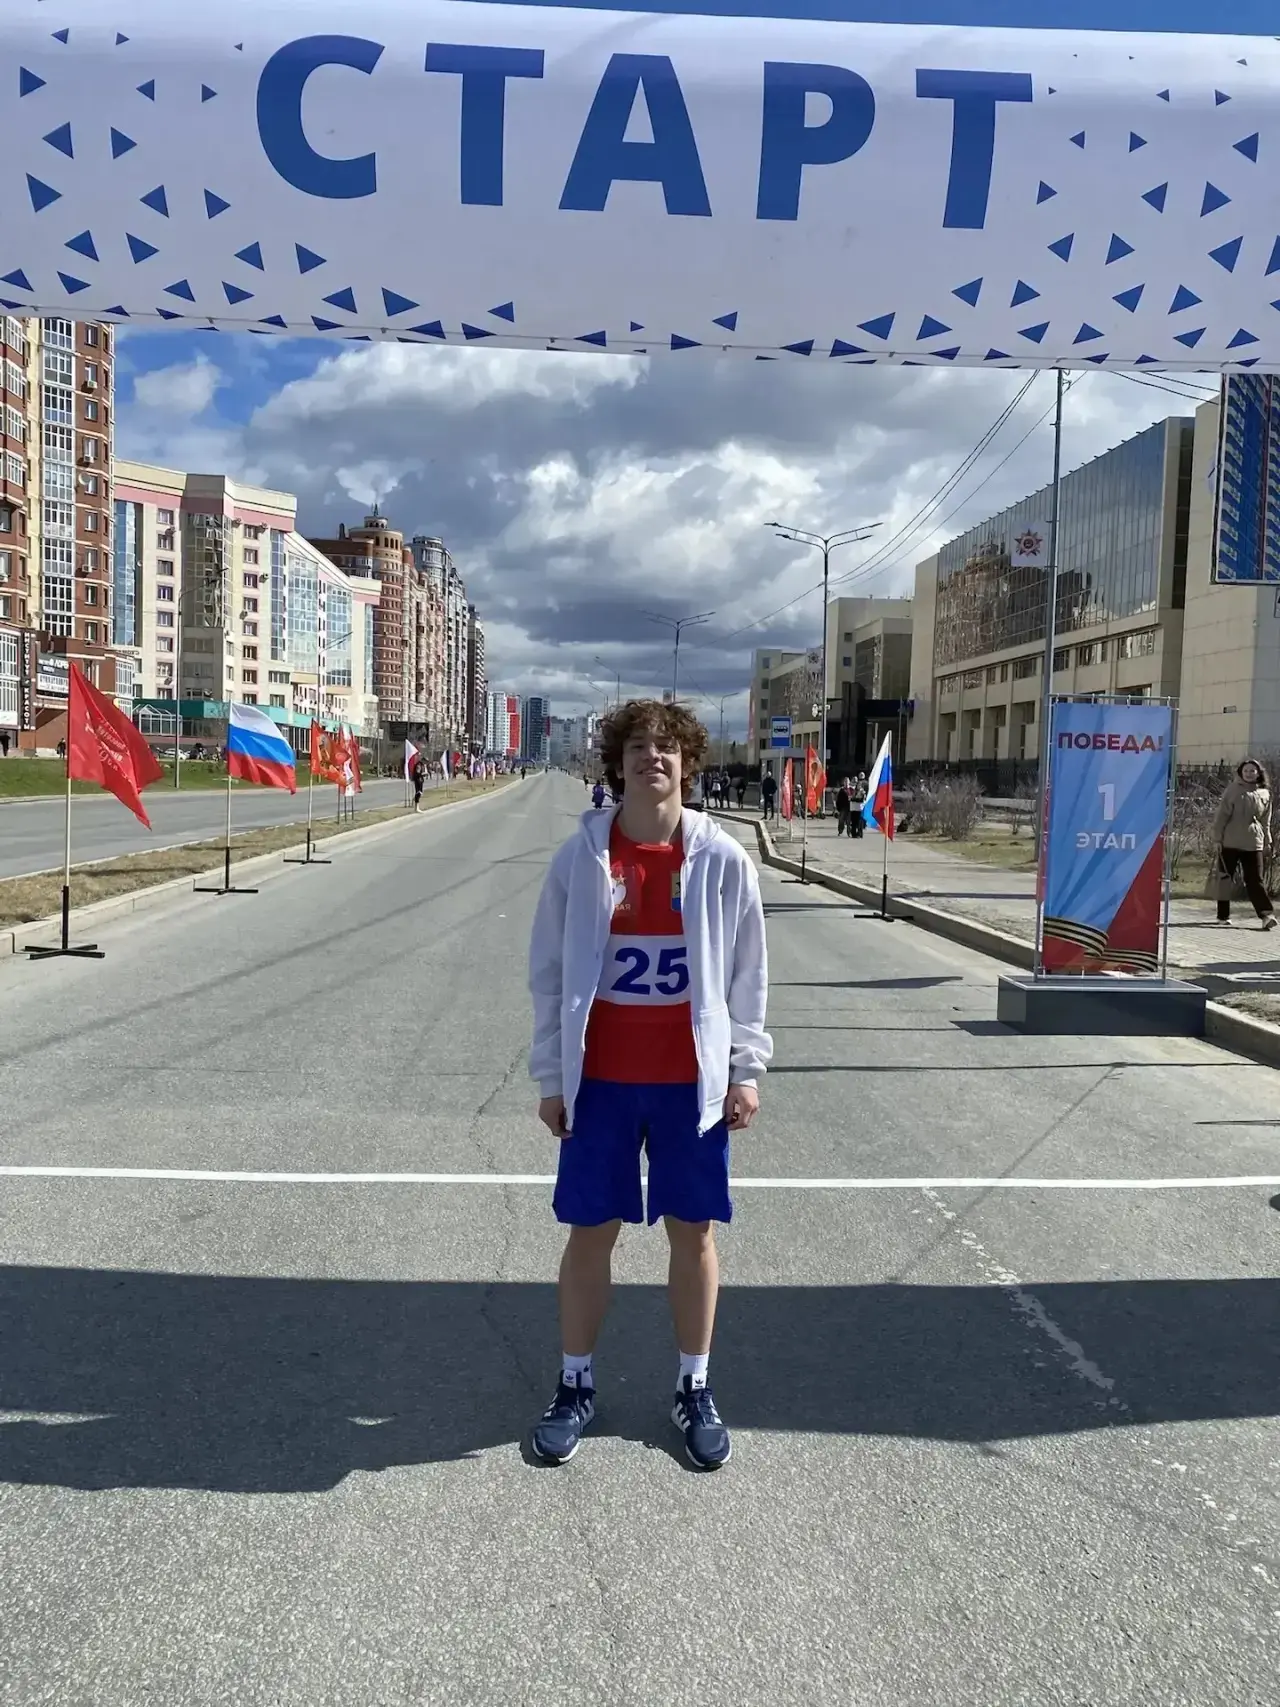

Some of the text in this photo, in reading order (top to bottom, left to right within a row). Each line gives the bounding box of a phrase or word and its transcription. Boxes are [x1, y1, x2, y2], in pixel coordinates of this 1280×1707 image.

[256, 34, 1033, 229] СТАРТ
[1058, 733, 1164, 754] ПОБЕДА!
[1097, 783, 1117, 821] 1
[1076, 832, 1137, 850] ЭТАП
[610, 947, 690, 996] 25
